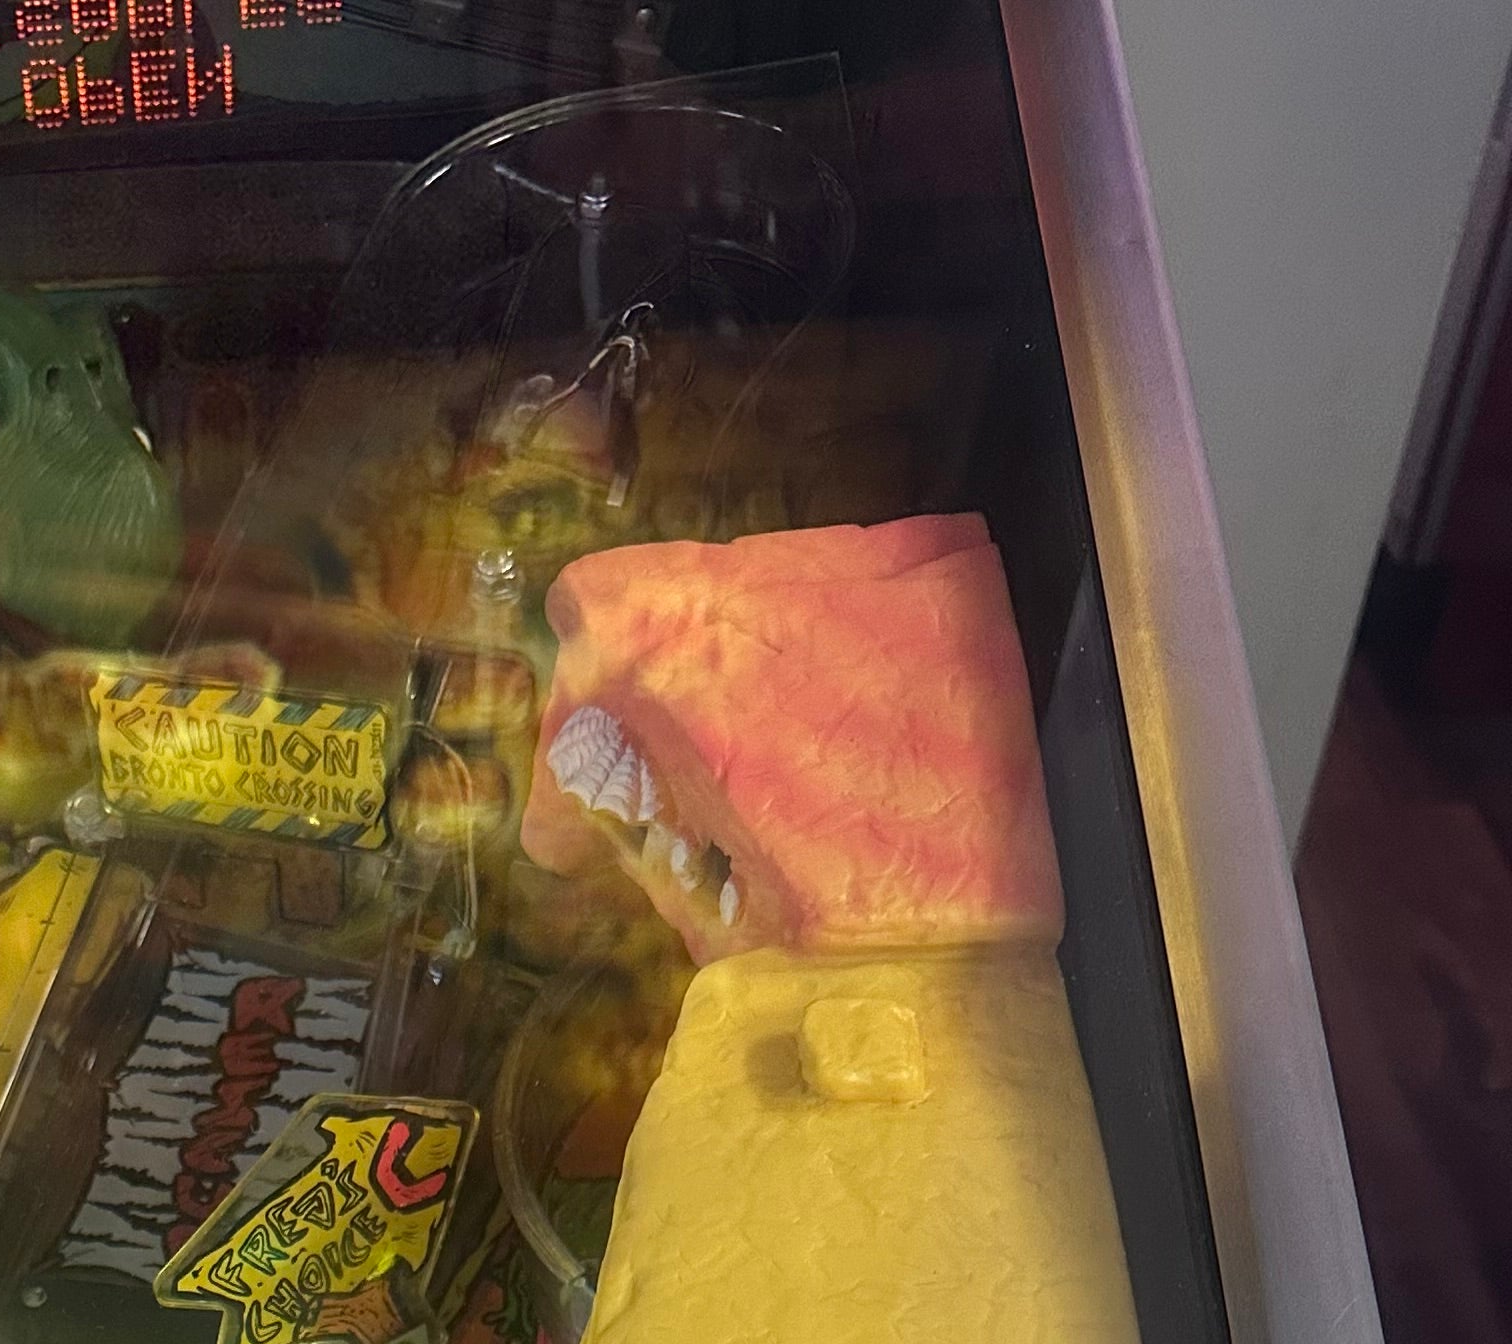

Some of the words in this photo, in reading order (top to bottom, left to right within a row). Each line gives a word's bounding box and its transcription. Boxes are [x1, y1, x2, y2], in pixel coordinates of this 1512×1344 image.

[115, 706, 360, 779] CAUTION
[109, 749, 226, 798] BRONTO
[234, 771, 377, 819] CROSSING
[207, 1158, 372, 1298] FRED'S
